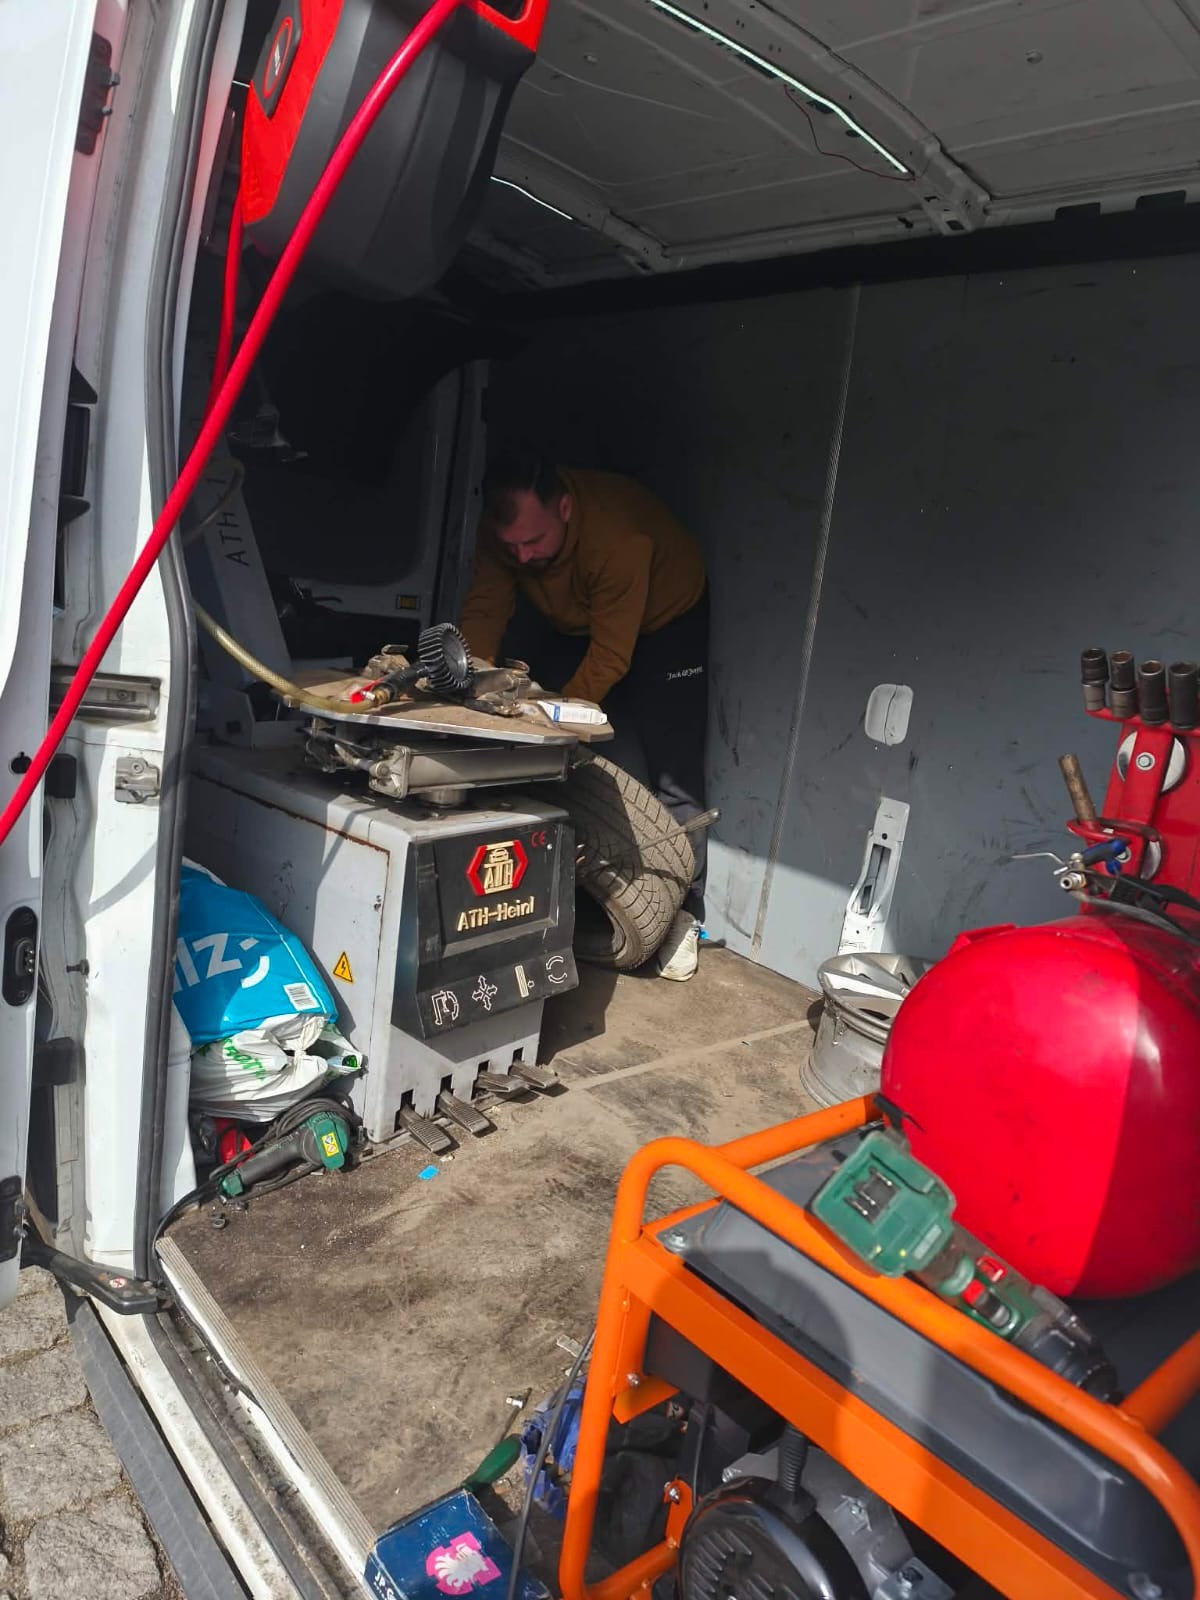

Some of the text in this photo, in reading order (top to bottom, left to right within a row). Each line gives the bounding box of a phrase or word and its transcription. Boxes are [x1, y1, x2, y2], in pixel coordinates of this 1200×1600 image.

[216, 512, 250, 567] ATH
[484, 860, 514, 890] ATH
[457, 896, 536, 932] ATH-Heinl
